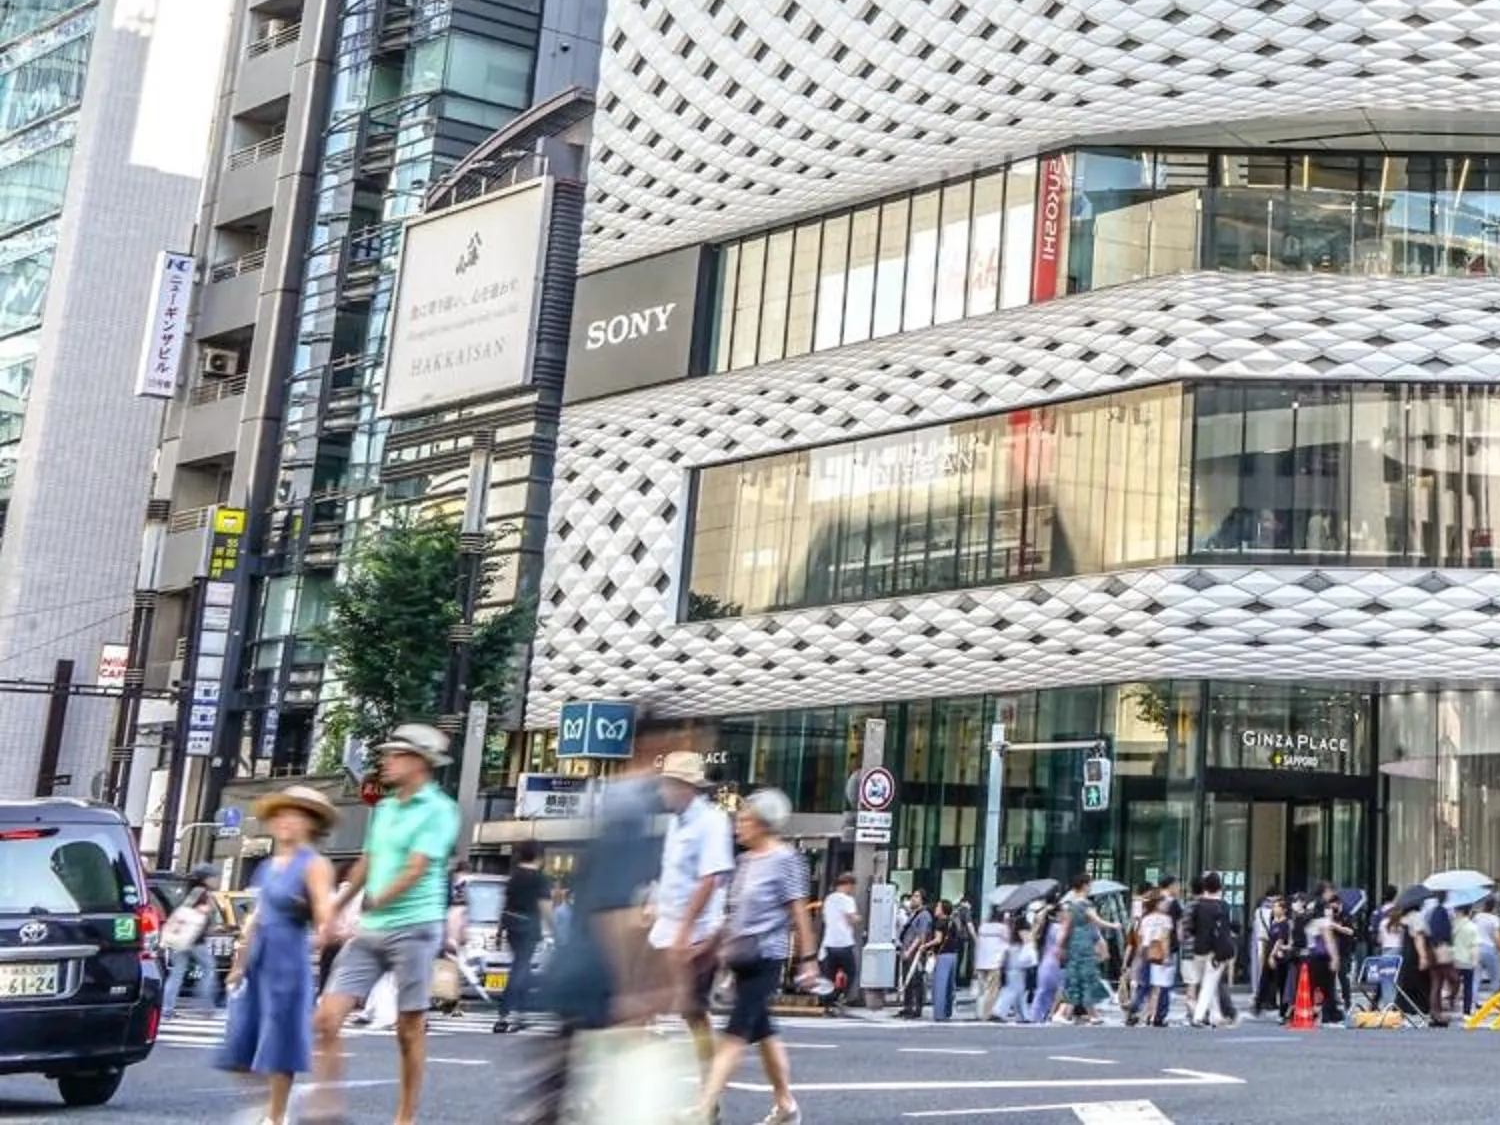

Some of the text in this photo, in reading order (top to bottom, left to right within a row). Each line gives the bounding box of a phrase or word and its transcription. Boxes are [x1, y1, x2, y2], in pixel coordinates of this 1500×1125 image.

[155, 275, 183, 373] ニューギンザビル
[585, 302, 676, 351] SONY
[409, 333, 509, 378] HAKKAISAN
[700, 750, 729, 765] LACE
[1242, 730, 1350, 753] GINZA PLACE
